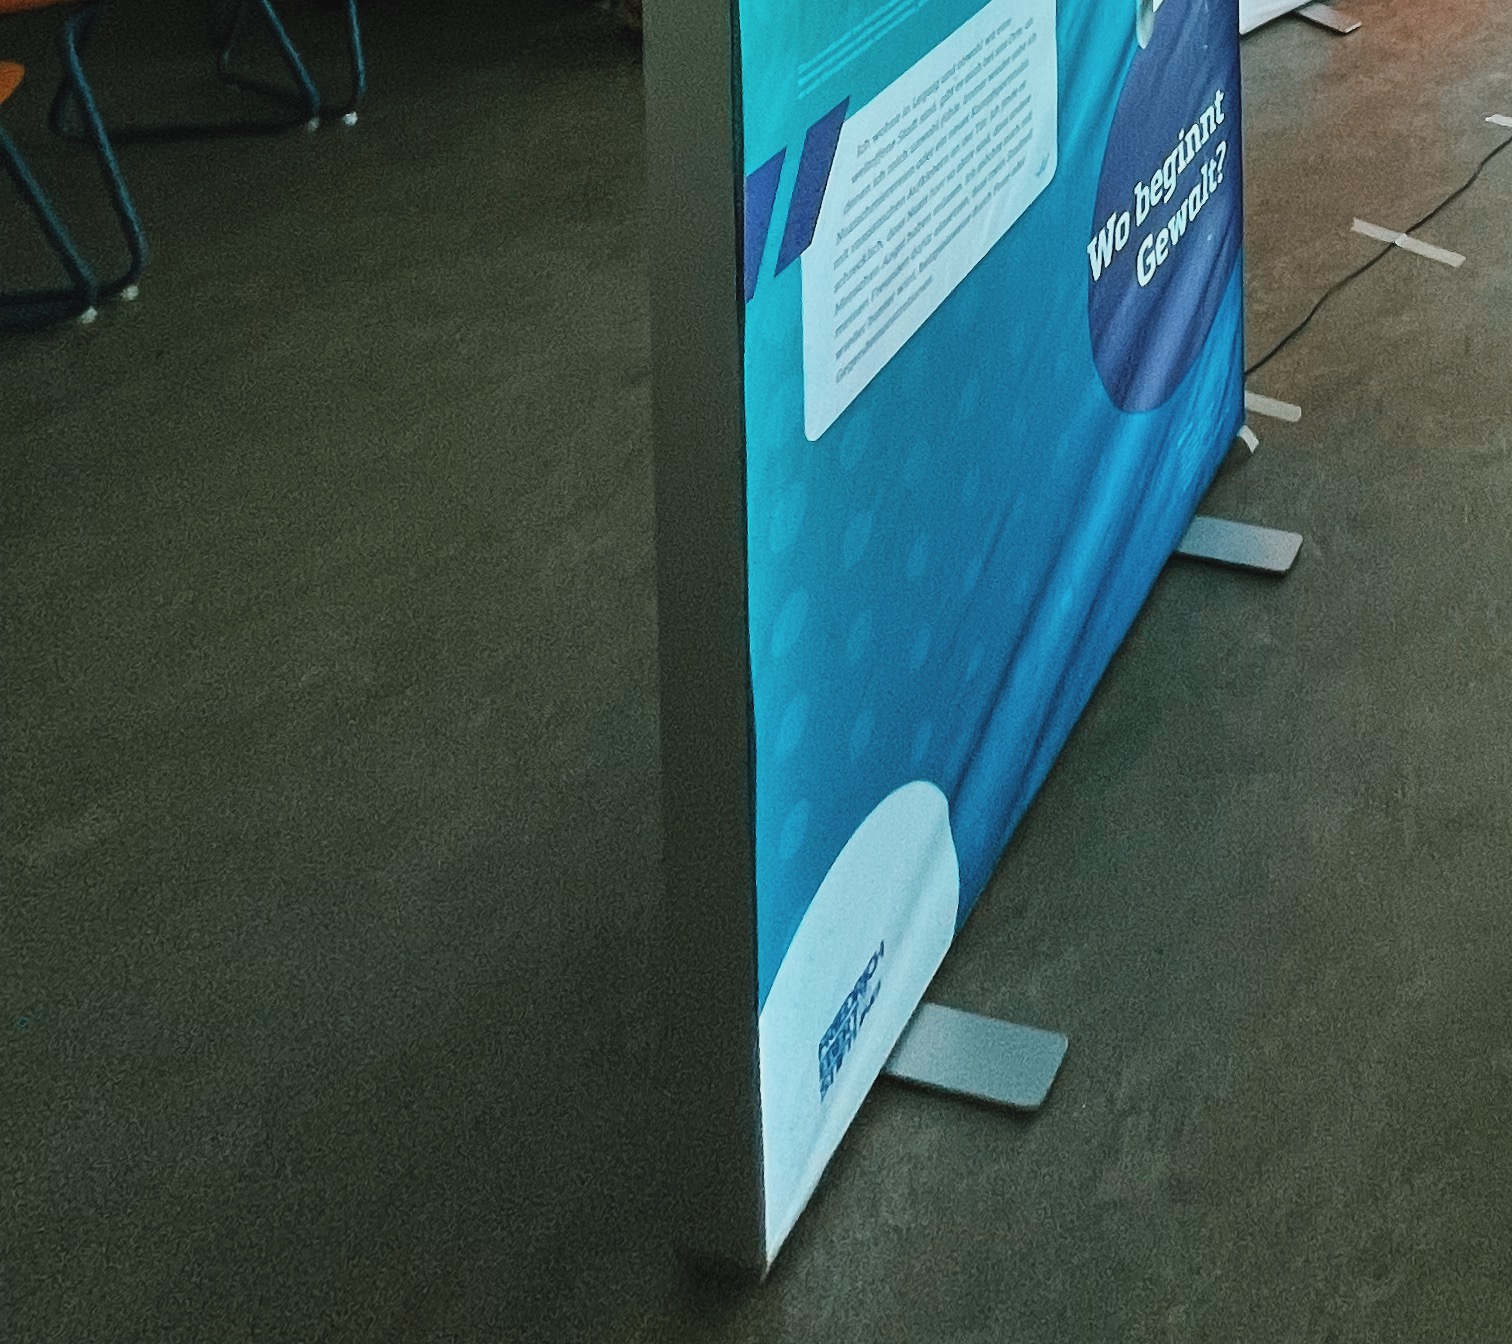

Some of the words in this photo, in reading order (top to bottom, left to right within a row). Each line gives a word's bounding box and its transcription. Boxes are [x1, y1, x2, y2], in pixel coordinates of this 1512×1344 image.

[1087, 209, 1131, 282] Wo
[1134, 89, 1225, 227] beginnt
[1136, 140, 1228, 288] Gewalt?
